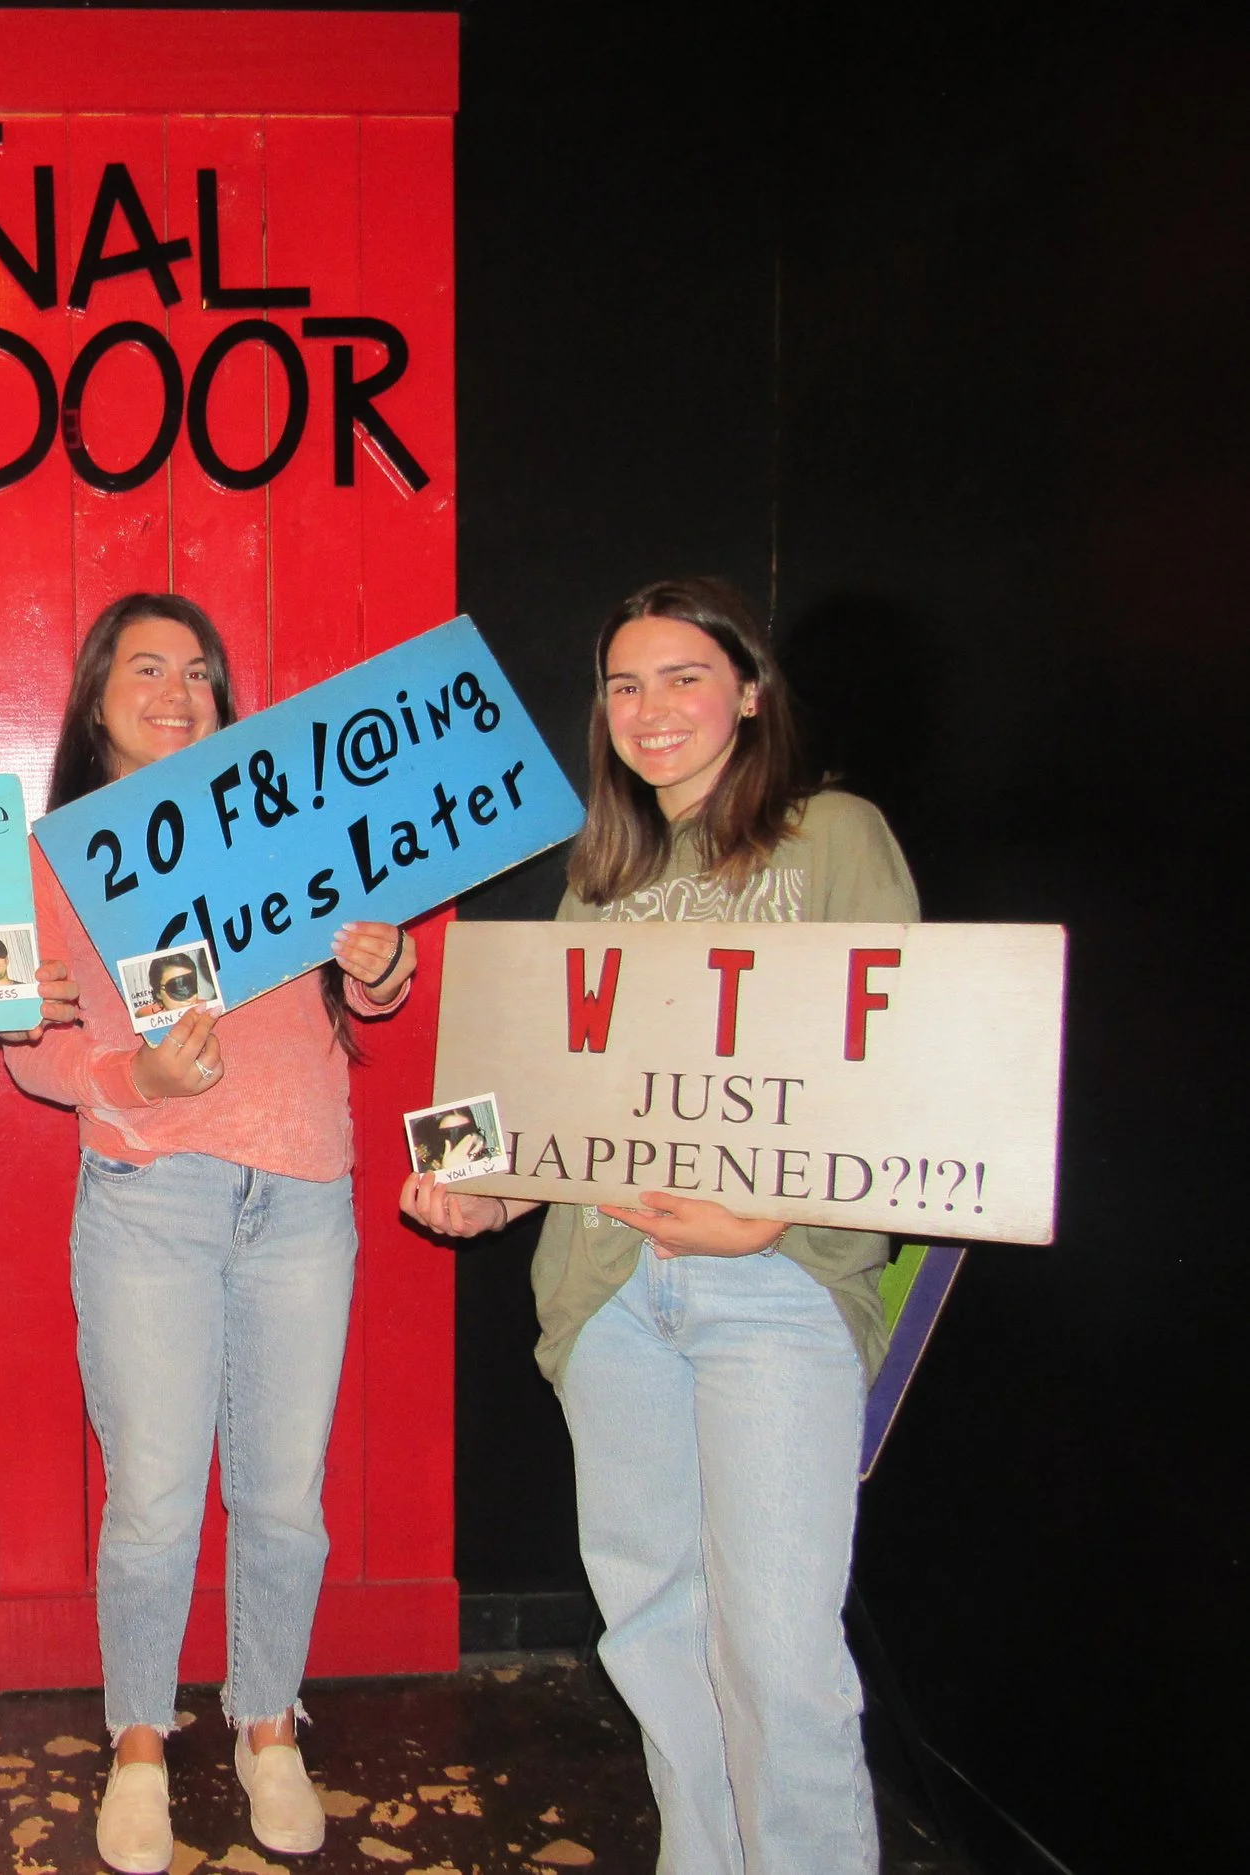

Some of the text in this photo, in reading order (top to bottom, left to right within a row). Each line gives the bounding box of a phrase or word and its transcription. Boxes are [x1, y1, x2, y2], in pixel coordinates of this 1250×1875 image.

[86, 800, 185, 902] 20
[347, 760, 526, 896] Later
[150, 1014, 174, 1028] CAN
[632, 1071, 805, 1126] JUST
